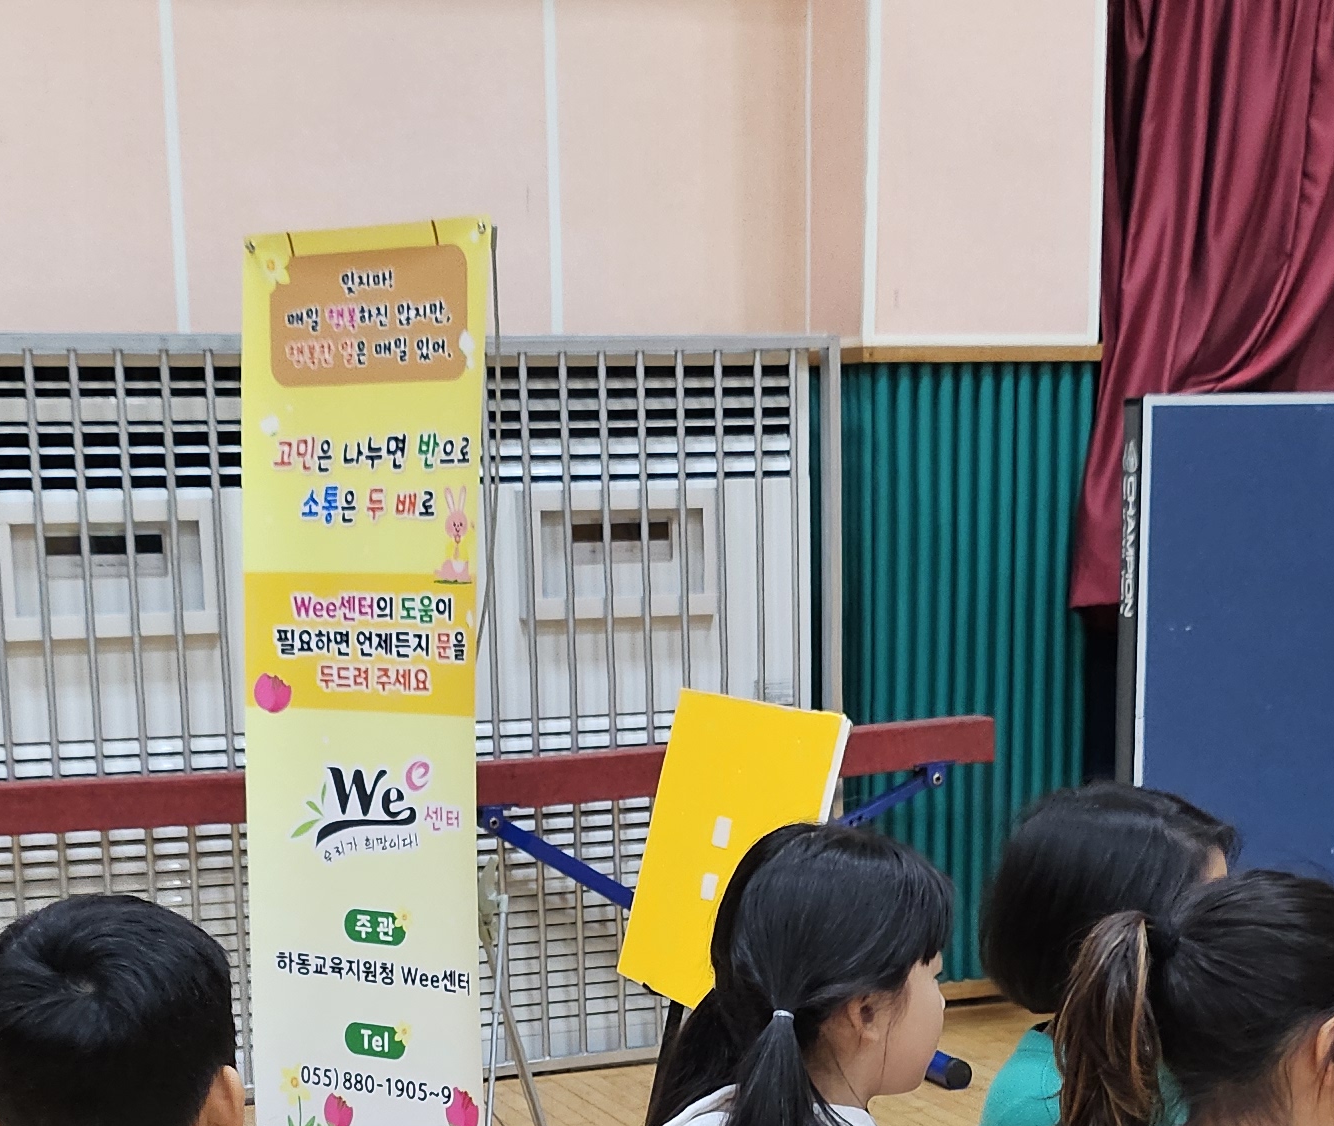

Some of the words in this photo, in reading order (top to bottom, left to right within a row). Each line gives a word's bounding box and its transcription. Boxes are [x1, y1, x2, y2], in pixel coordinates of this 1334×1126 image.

[340, 267, 394, 296] 잊지마!
[287, 306, 320, 332] 매일
[327, 304, 389, 332] 행복하진
[396, 300, 452, 327] 않지만,
[287, 342, 333, 367] 행복한
[340, 340, 367, 366] 일은
[374, 336, 408, 363] 매일
[416, 336, 453, 362] 있어.
[273, 436, 333, 473] 고민은
[343, 433, 407, 470] 나누면
[417, 432, 471, 470] 반으로
[301, 485, 357, 524] 소통은
[366, 488, 384, 521] 두
[395, 489, 435, 518] 배로
[1123, 474, 1138, 618] CHAMPION
[293, 595, 394, 623] Wee센터의
[399, 595, 453, 624] 도움이
[276, 629, 350, 656] 필요하면
[355, 630, 430, 659] 언제든지
[436, 631, 466, 662] 문을
[319, 665, 370, 690] 두드려
[375, 667, 430, 693] 주세요
[423, 806, 460, 832] 센터
[323, 837, 358, 863] 우리가
[364, 833, 419, 851] 희망이다!
[275, 951, 396, 986] 하동교육지원청
[400, 965, 471, 996] Wee센터
[360, 1029, 389, 1053] Tel
[300, 1065, 453, 1105] 055)880-1905~9
